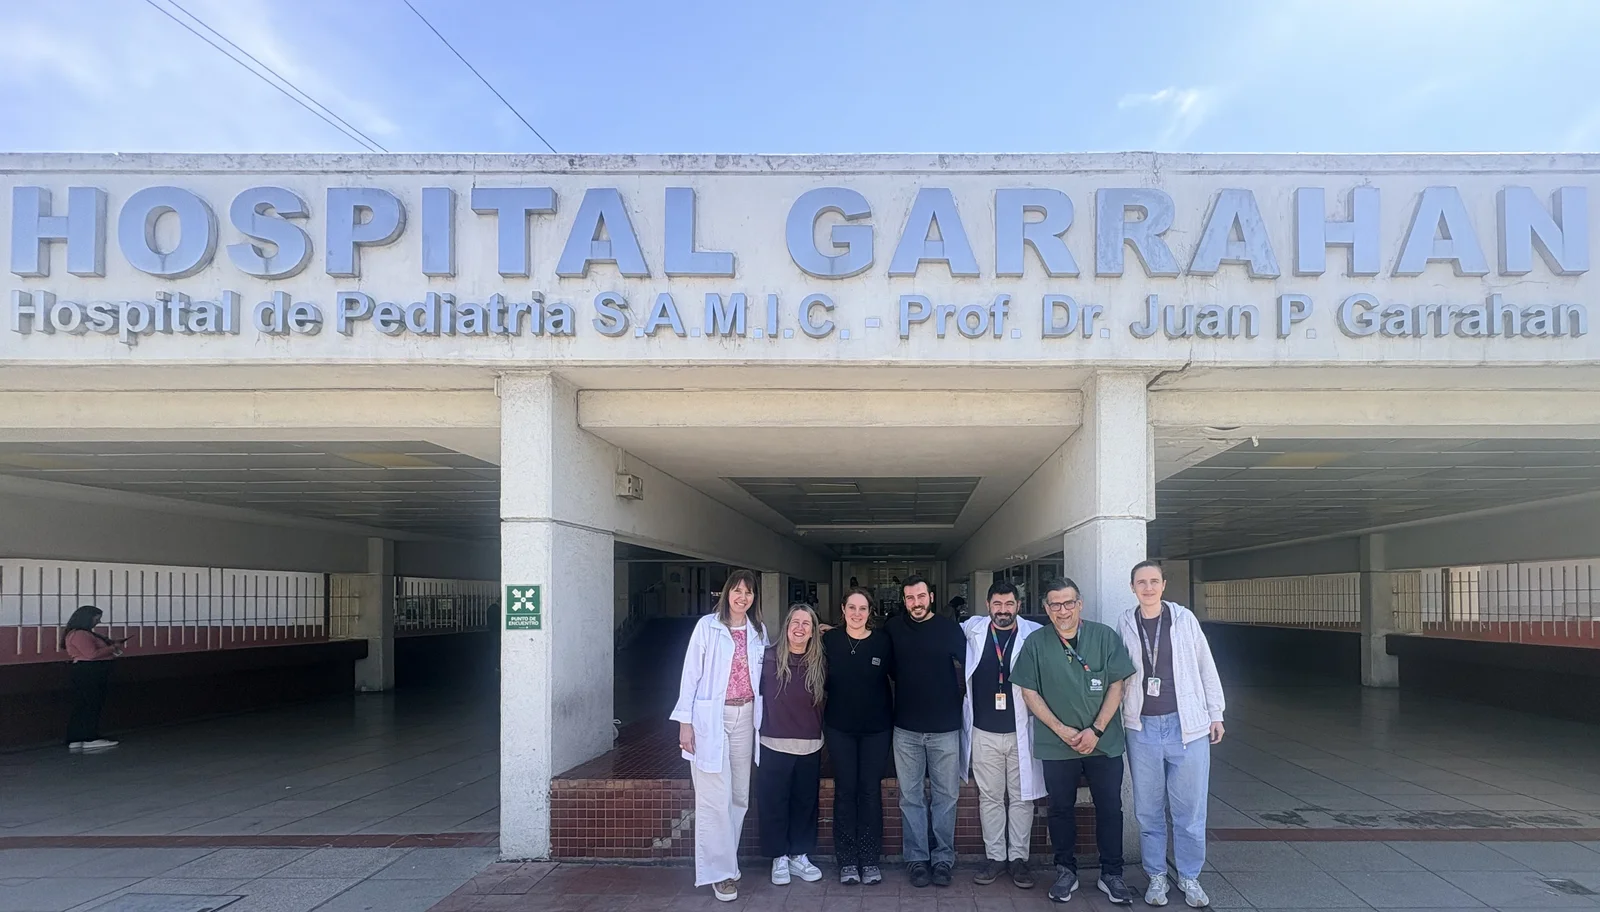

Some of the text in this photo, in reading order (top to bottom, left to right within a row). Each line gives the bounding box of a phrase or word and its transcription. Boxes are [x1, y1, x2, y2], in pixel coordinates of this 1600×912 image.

[10, 186, 1590, 280] HOSPITAL GARRAHAN
[10, 290, 241, 346] Hospital
[253, 291, 322, 336] de
[337, 291, 575, 337] Pediatria
[592, 292, 850, 340] S.A.M.I.C.
[899, 294, 1021, 339] Prof.
[1041, 294, 1111, 339] Dr.
[1129, 294, 1259, 339] Juan
[1276, 294, 1317, 339] P.
[1336, 293, 1588, 339] Garrahan
